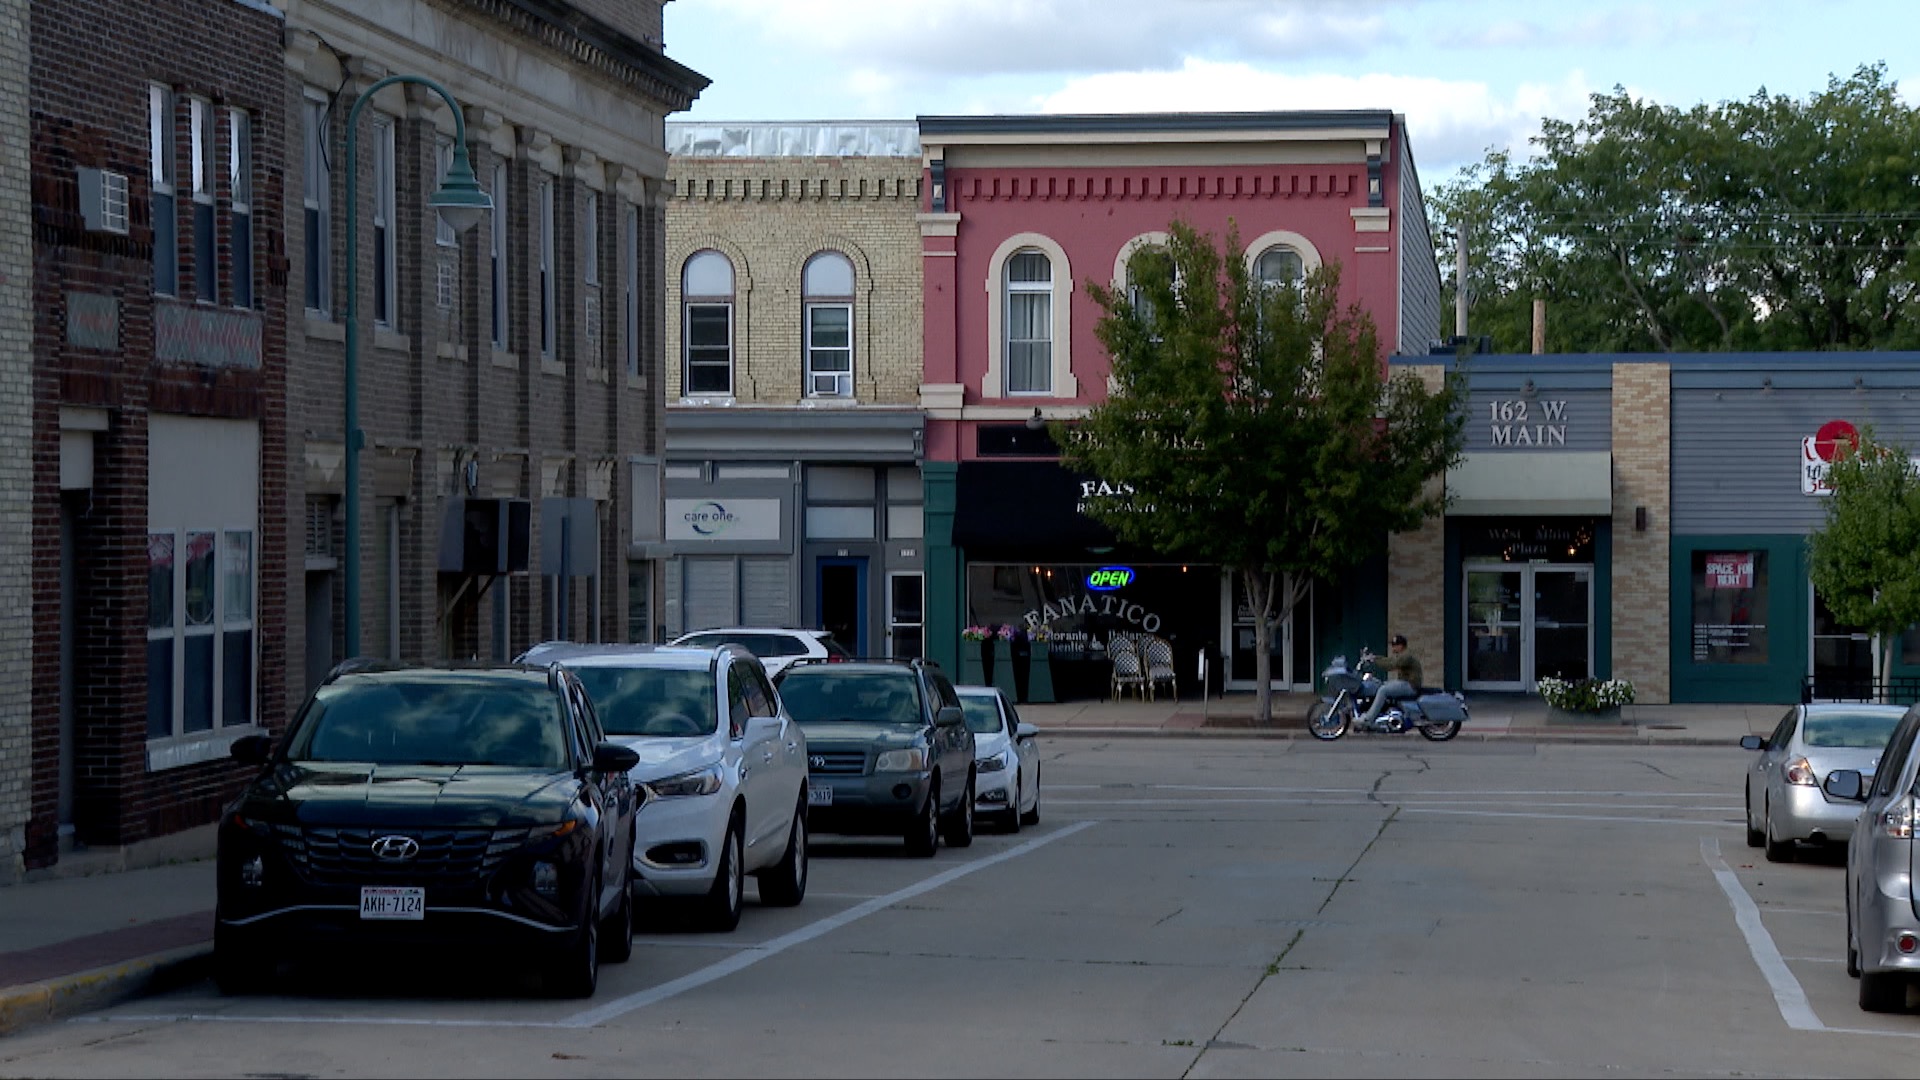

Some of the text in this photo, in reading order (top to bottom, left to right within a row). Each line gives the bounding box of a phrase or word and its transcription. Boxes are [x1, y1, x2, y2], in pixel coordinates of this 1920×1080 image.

[1489, 400, 1568, 421] 162 W.
[1490, 424, 1567, 446] MAIN
[684, 512, 734, 522] care one
[1705, 563, 1734, 574] SPACE
[1089, 570, 1130, 587] OPEN
[1717, 574, 1740, 585] RENT
[1023, 593, 1161, 633] FANATICO
[363, 897, 421, 912] AKH-7124
